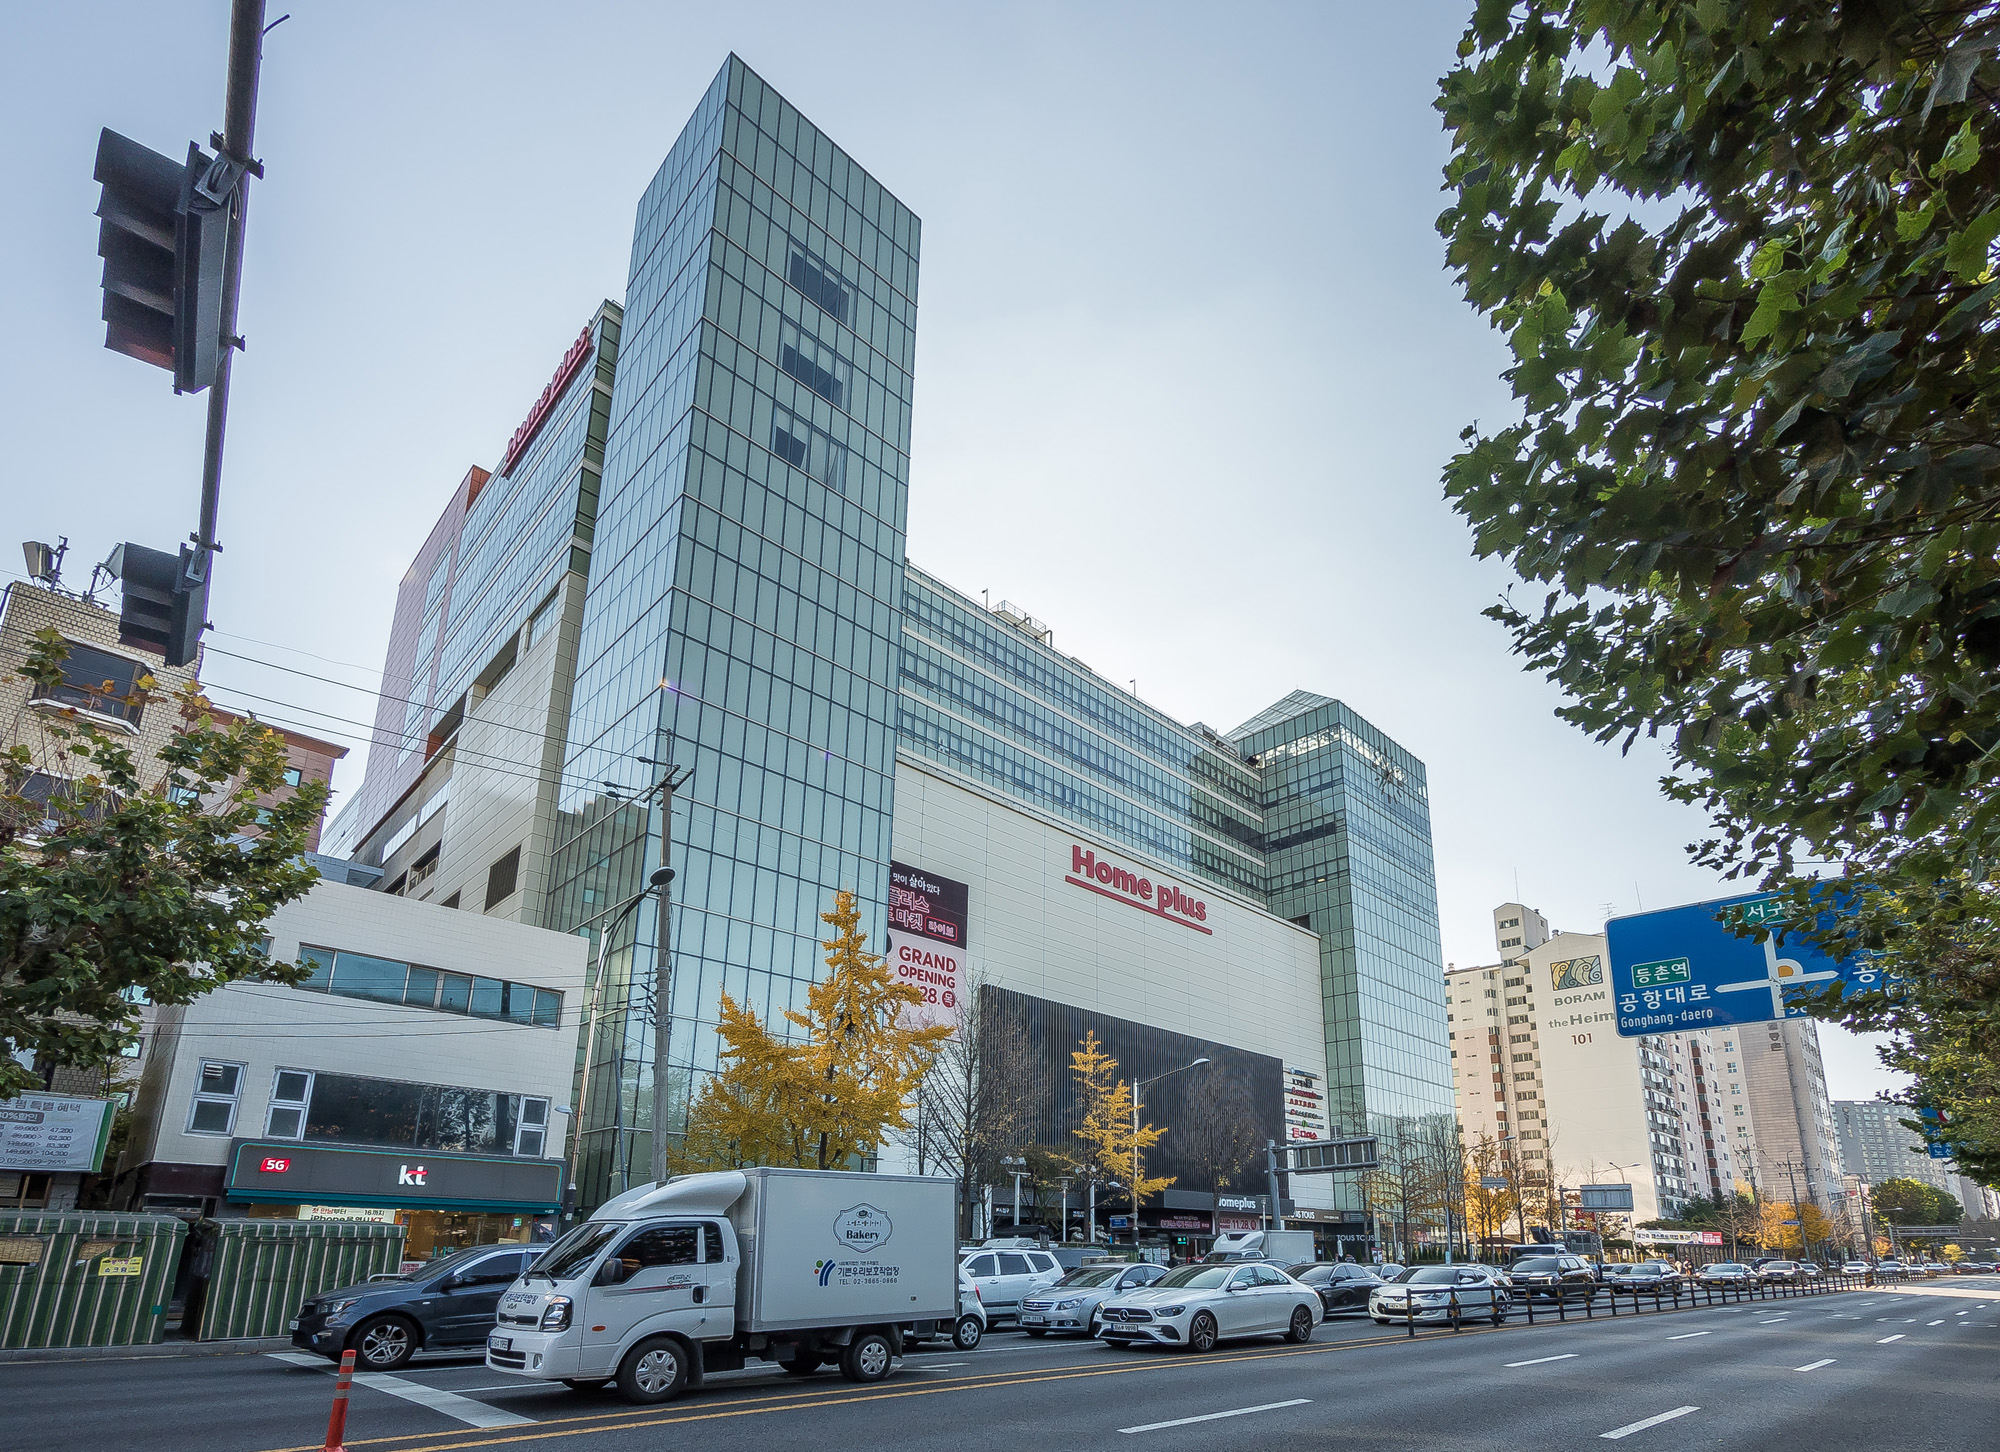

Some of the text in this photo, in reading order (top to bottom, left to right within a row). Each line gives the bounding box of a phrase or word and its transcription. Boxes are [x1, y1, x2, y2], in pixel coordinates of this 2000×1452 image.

[1072, 844, 1207, 921] Home plus
[898, 945, 957, 973] GRAND
[898, 964, 956, 989] OPENING
[1636, 962, 1687, 984] 등촌역
[1554, 991, 1606, 1006] BORAM
[1618, 984, 1711, 1013] 공항대로
[1620, 1008, 1713, 1028] Gonghang-daero
[1571, 1033, 1592, 1045] 101
[266, 1159, 286, 1171] 5G
[398, 1164, 428, 1186] kt
[846, 1230, 881, 1242] Bakery
[1337, 1234, 1356, 1242] TOUS
[837, 1266, 900, 1277] 기쁜우리보호작업장
